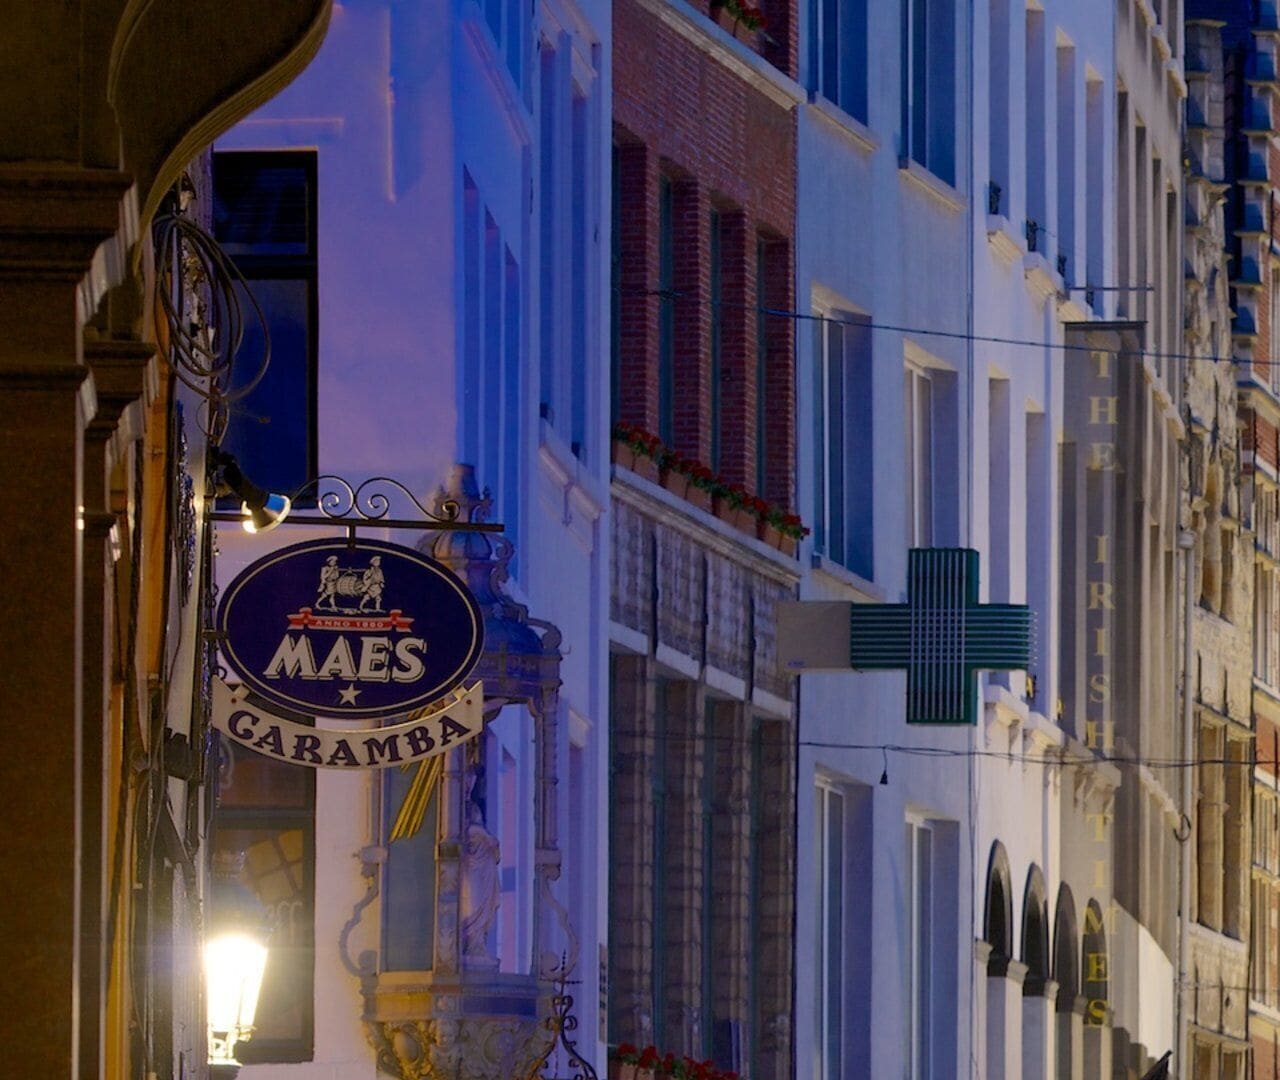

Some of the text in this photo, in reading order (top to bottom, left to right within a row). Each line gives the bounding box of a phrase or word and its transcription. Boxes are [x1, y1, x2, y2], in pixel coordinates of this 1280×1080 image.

[262, 633, 428, 684] MAES
[1086, 535, 1116, 750] IRISH
[227, 710, 472, 768] CARAMBA
[1083, 814, 1118, 1028] TIMES
